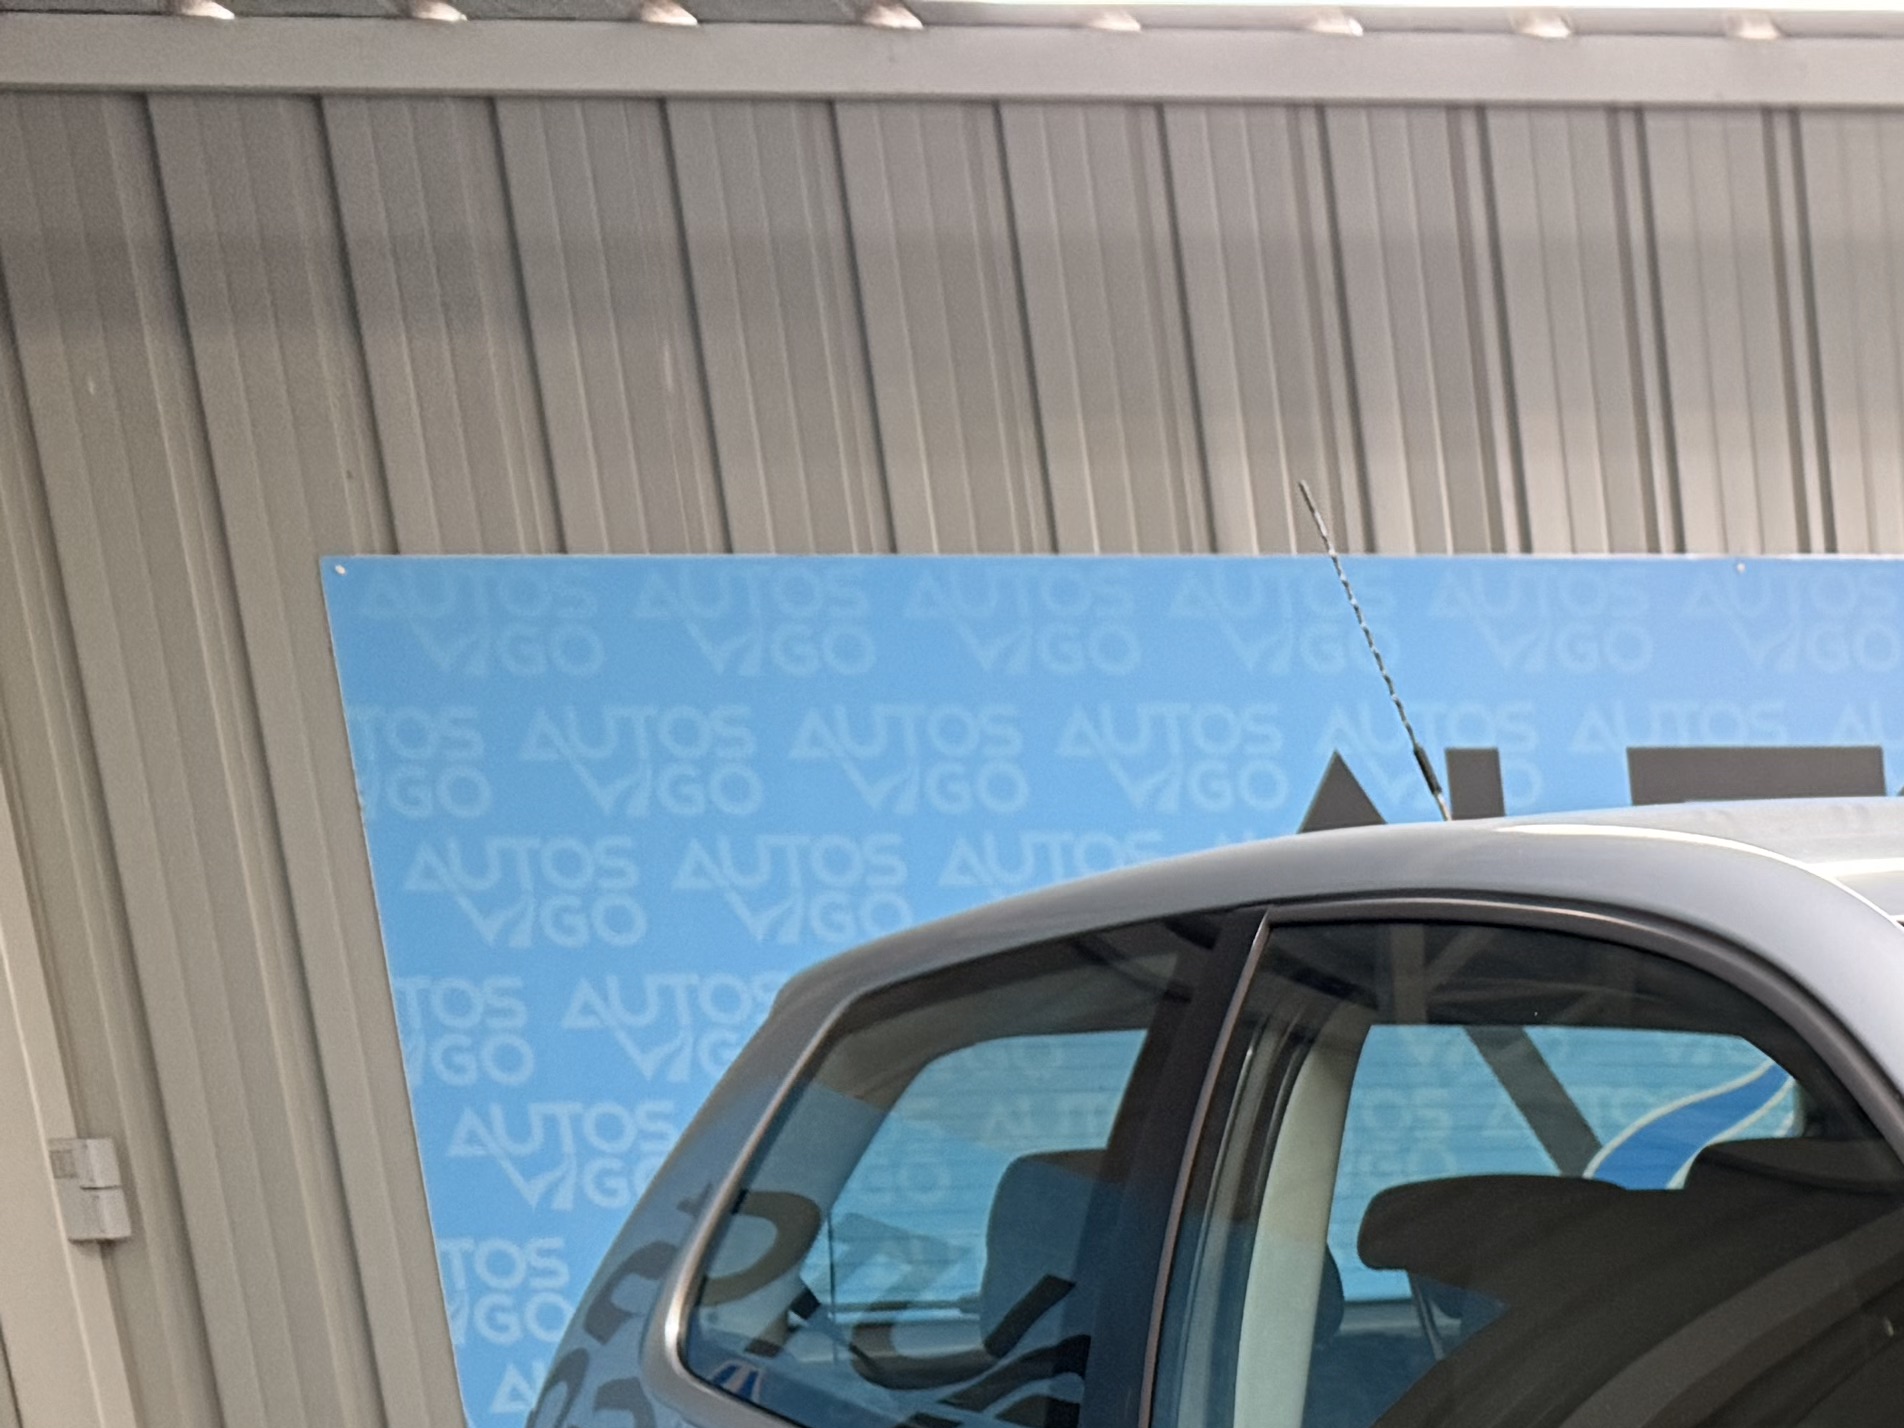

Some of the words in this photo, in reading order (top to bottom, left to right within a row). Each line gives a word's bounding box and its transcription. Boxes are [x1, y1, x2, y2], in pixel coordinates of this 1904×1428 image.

[359, 567, 600, 618] AUTOS
[633, 567, 870, 618] AUTOS
[902, 567, 1136, 618] AUTOS
[1167, 567, 1397, 618] AUTOS
[1425, 567, 1650, 618] AUTOS
[1681, 567, 1899, 618] AUTOS
[408, 622, 605, 676] VIGO
[685, 622, 876, 676] VIGO
[955, 622, 1142, 675] VIGO
[1218, 622, 1400, 675] VIGO
[1473, 622, 1652, 675] VIGO
[1731, 622, 1902, 674] VIGO
[520, 706, 755, 760] AUTOS
[789, 705, 1022, 759] AUTOS
[1058, 704, 1282, 756] AUTOS
[569, 763, 763, 818] VIGO
[837, 762, 1029, 816] VIGO
[1103, 760, 1289, 812] VIGO
[402, 835, 638, 891] AUTOS
[670, 834, 908, 889] AUTOS
[451, 892, 648, 949] VIGO
[722, 891, 913, 946] VIGO
[447, 1101, 682, 1158] AUTOS
